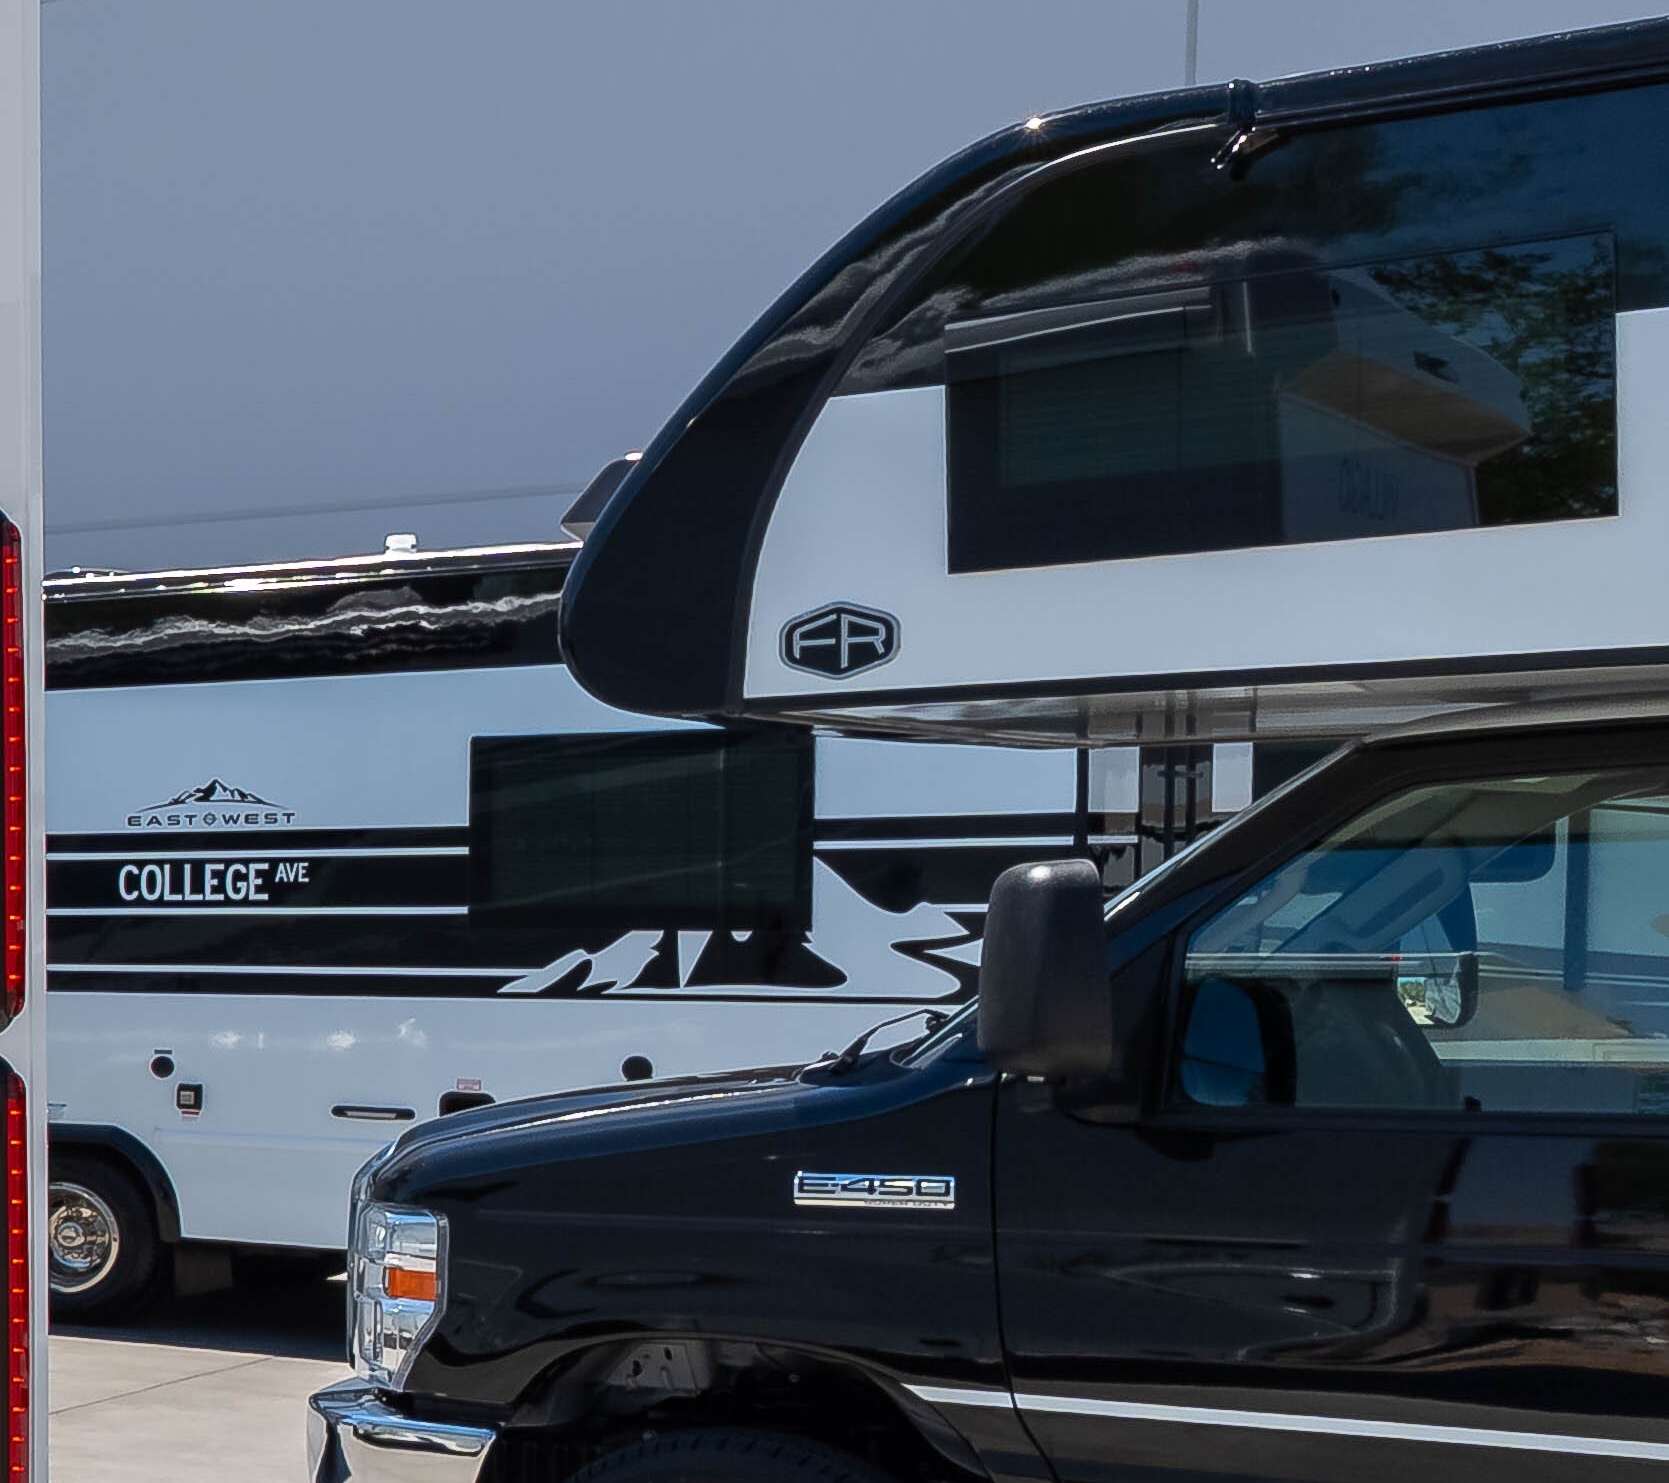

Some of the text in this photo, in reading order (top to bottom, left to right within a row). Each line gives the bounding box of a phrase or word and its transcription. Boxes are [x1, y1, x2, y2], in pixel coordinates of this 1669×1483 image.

[127, 812, 296, 827] EAST WEST
[119, 862, 309, 901] COLLEGE AVE
